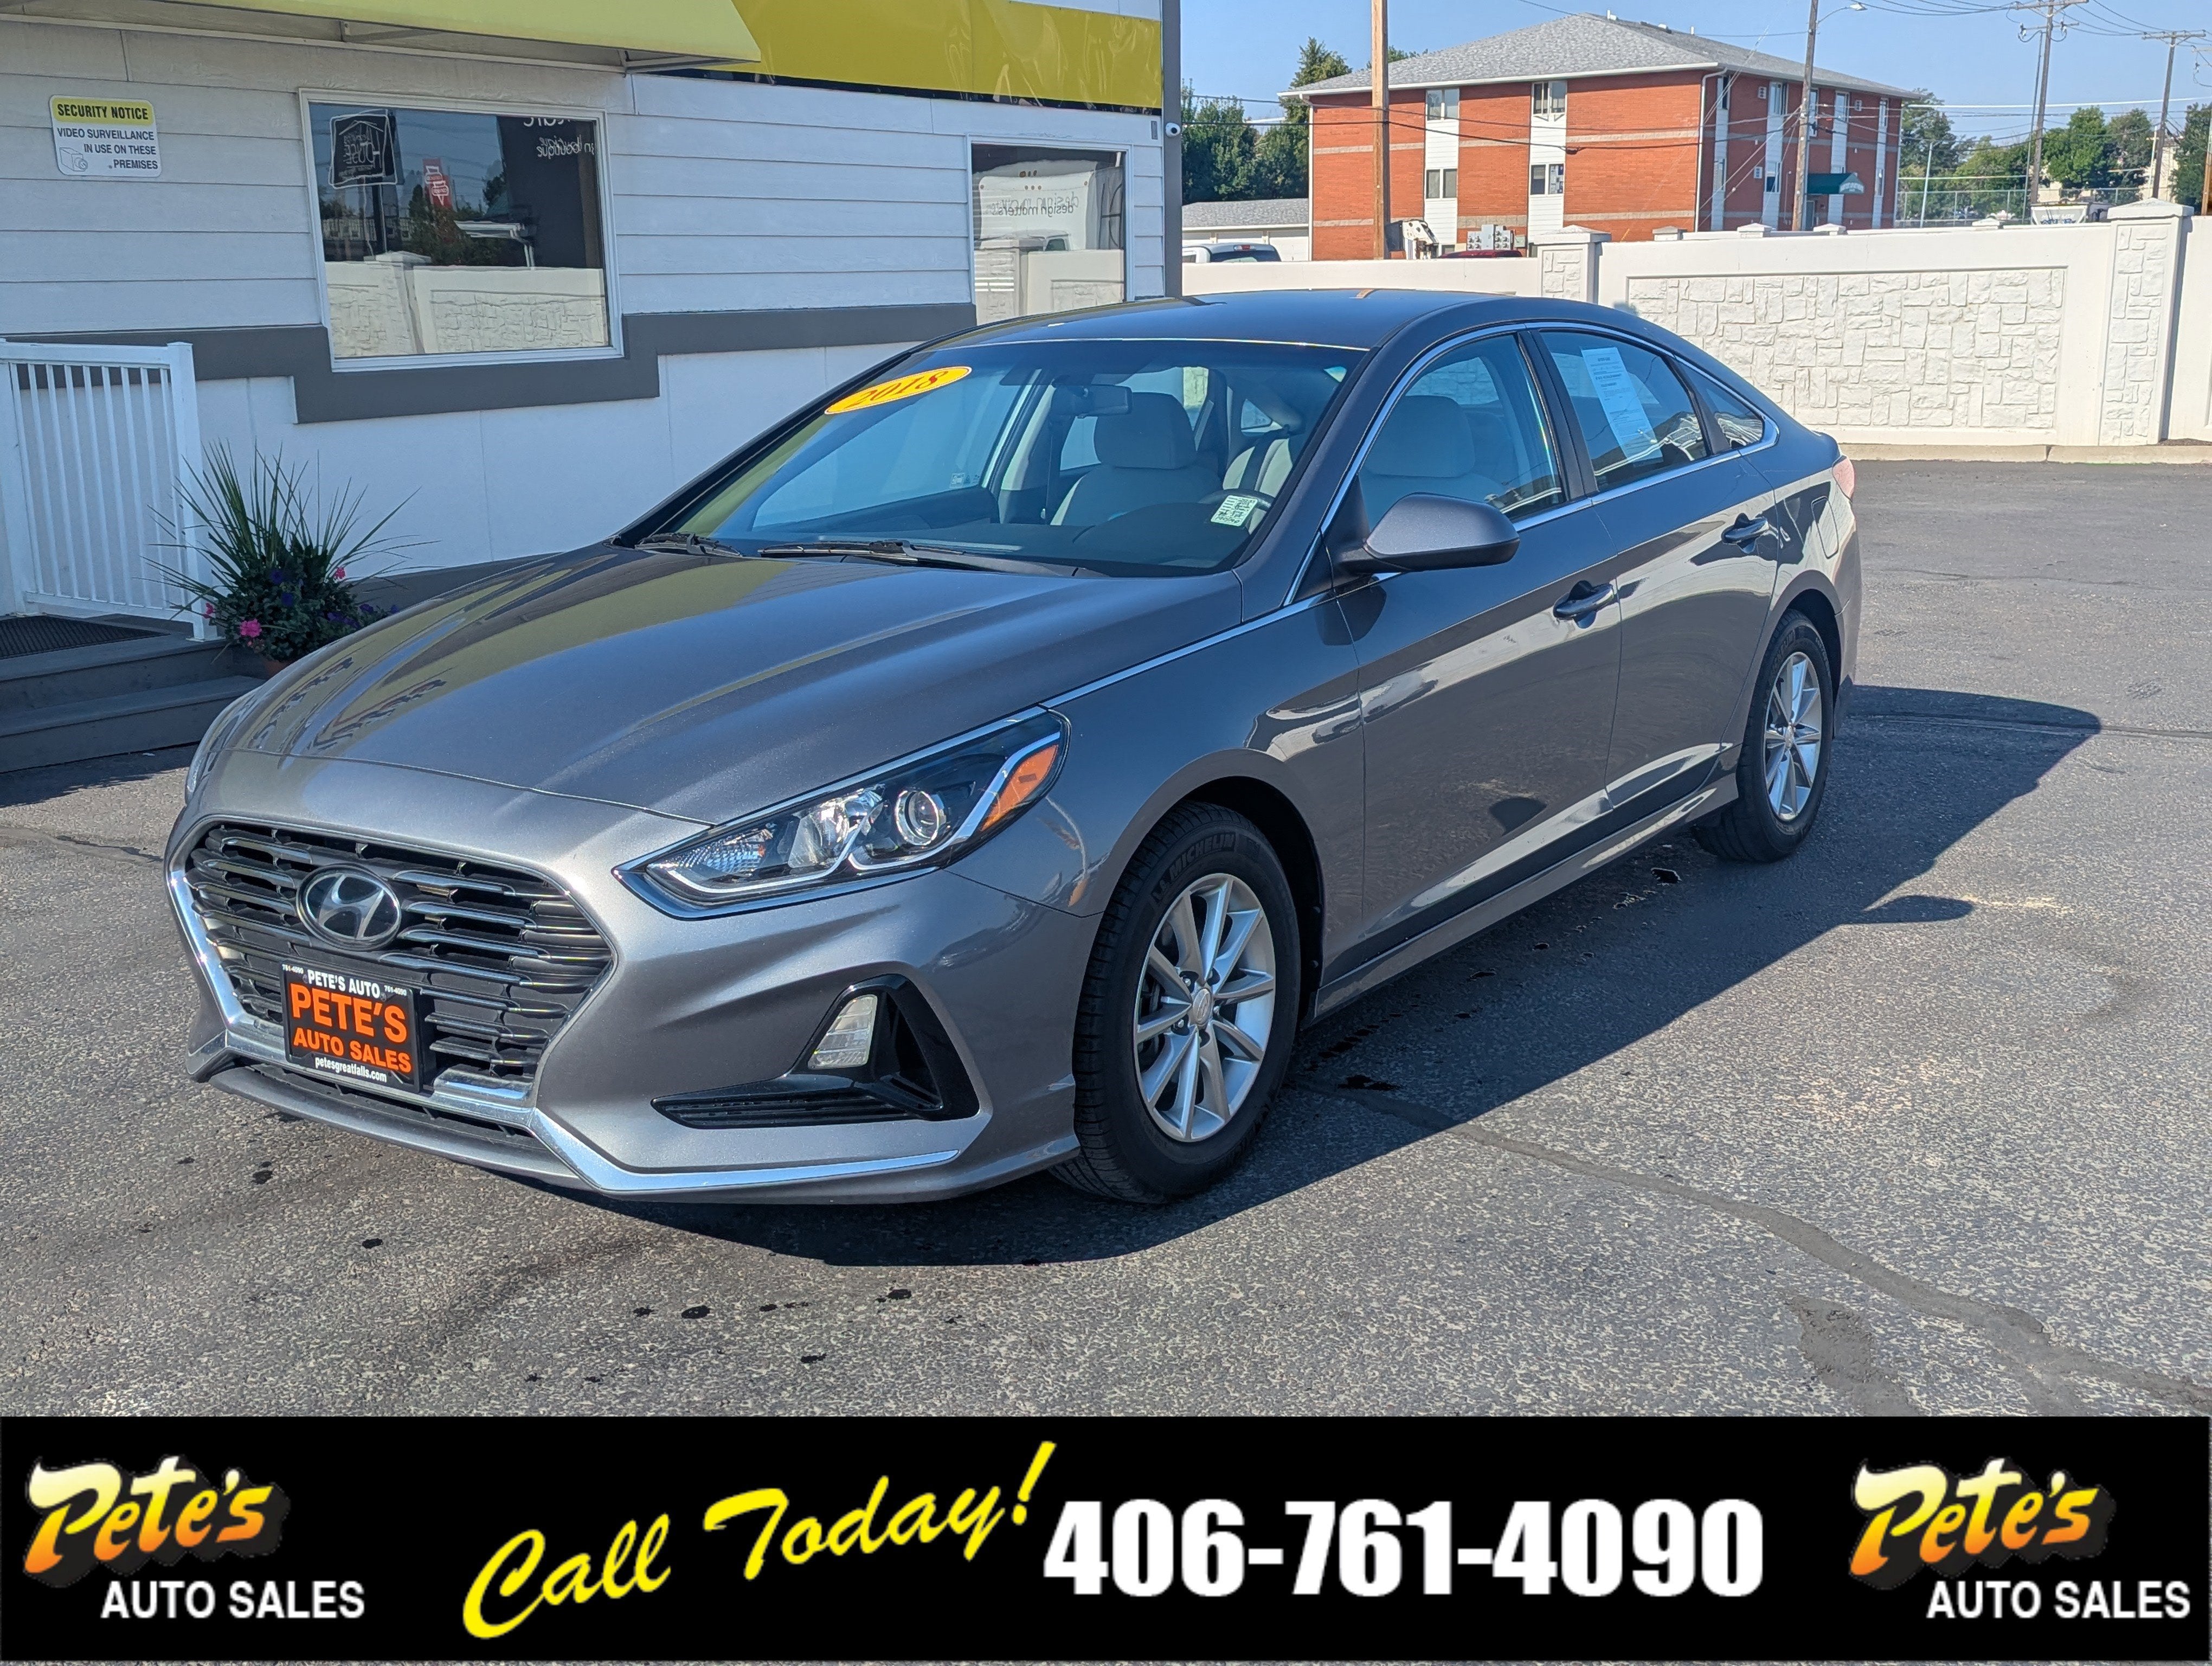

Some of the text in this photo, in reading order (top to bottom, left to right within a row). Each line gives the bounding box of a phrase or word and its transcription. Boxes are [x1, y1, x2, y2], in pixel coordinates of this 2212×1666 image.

[57, 103, 149, 120] SECURITY NOTICE
[57, 127, 155, 140] VIDEO SURVEILLANCE
[83, 143, 157, 155] IN USE ON THESE
[113, 159, 158, 169] PREMISES
[842, 370, 949, 409] 2018
[1169, 833, 1236, 881] MICHELIN
[307, 969, 380, 999] PETE'S AUTO
[290, 983, 407, 1043] PETE'S
[293, 1028, 412, 1073] AUTO SALES
